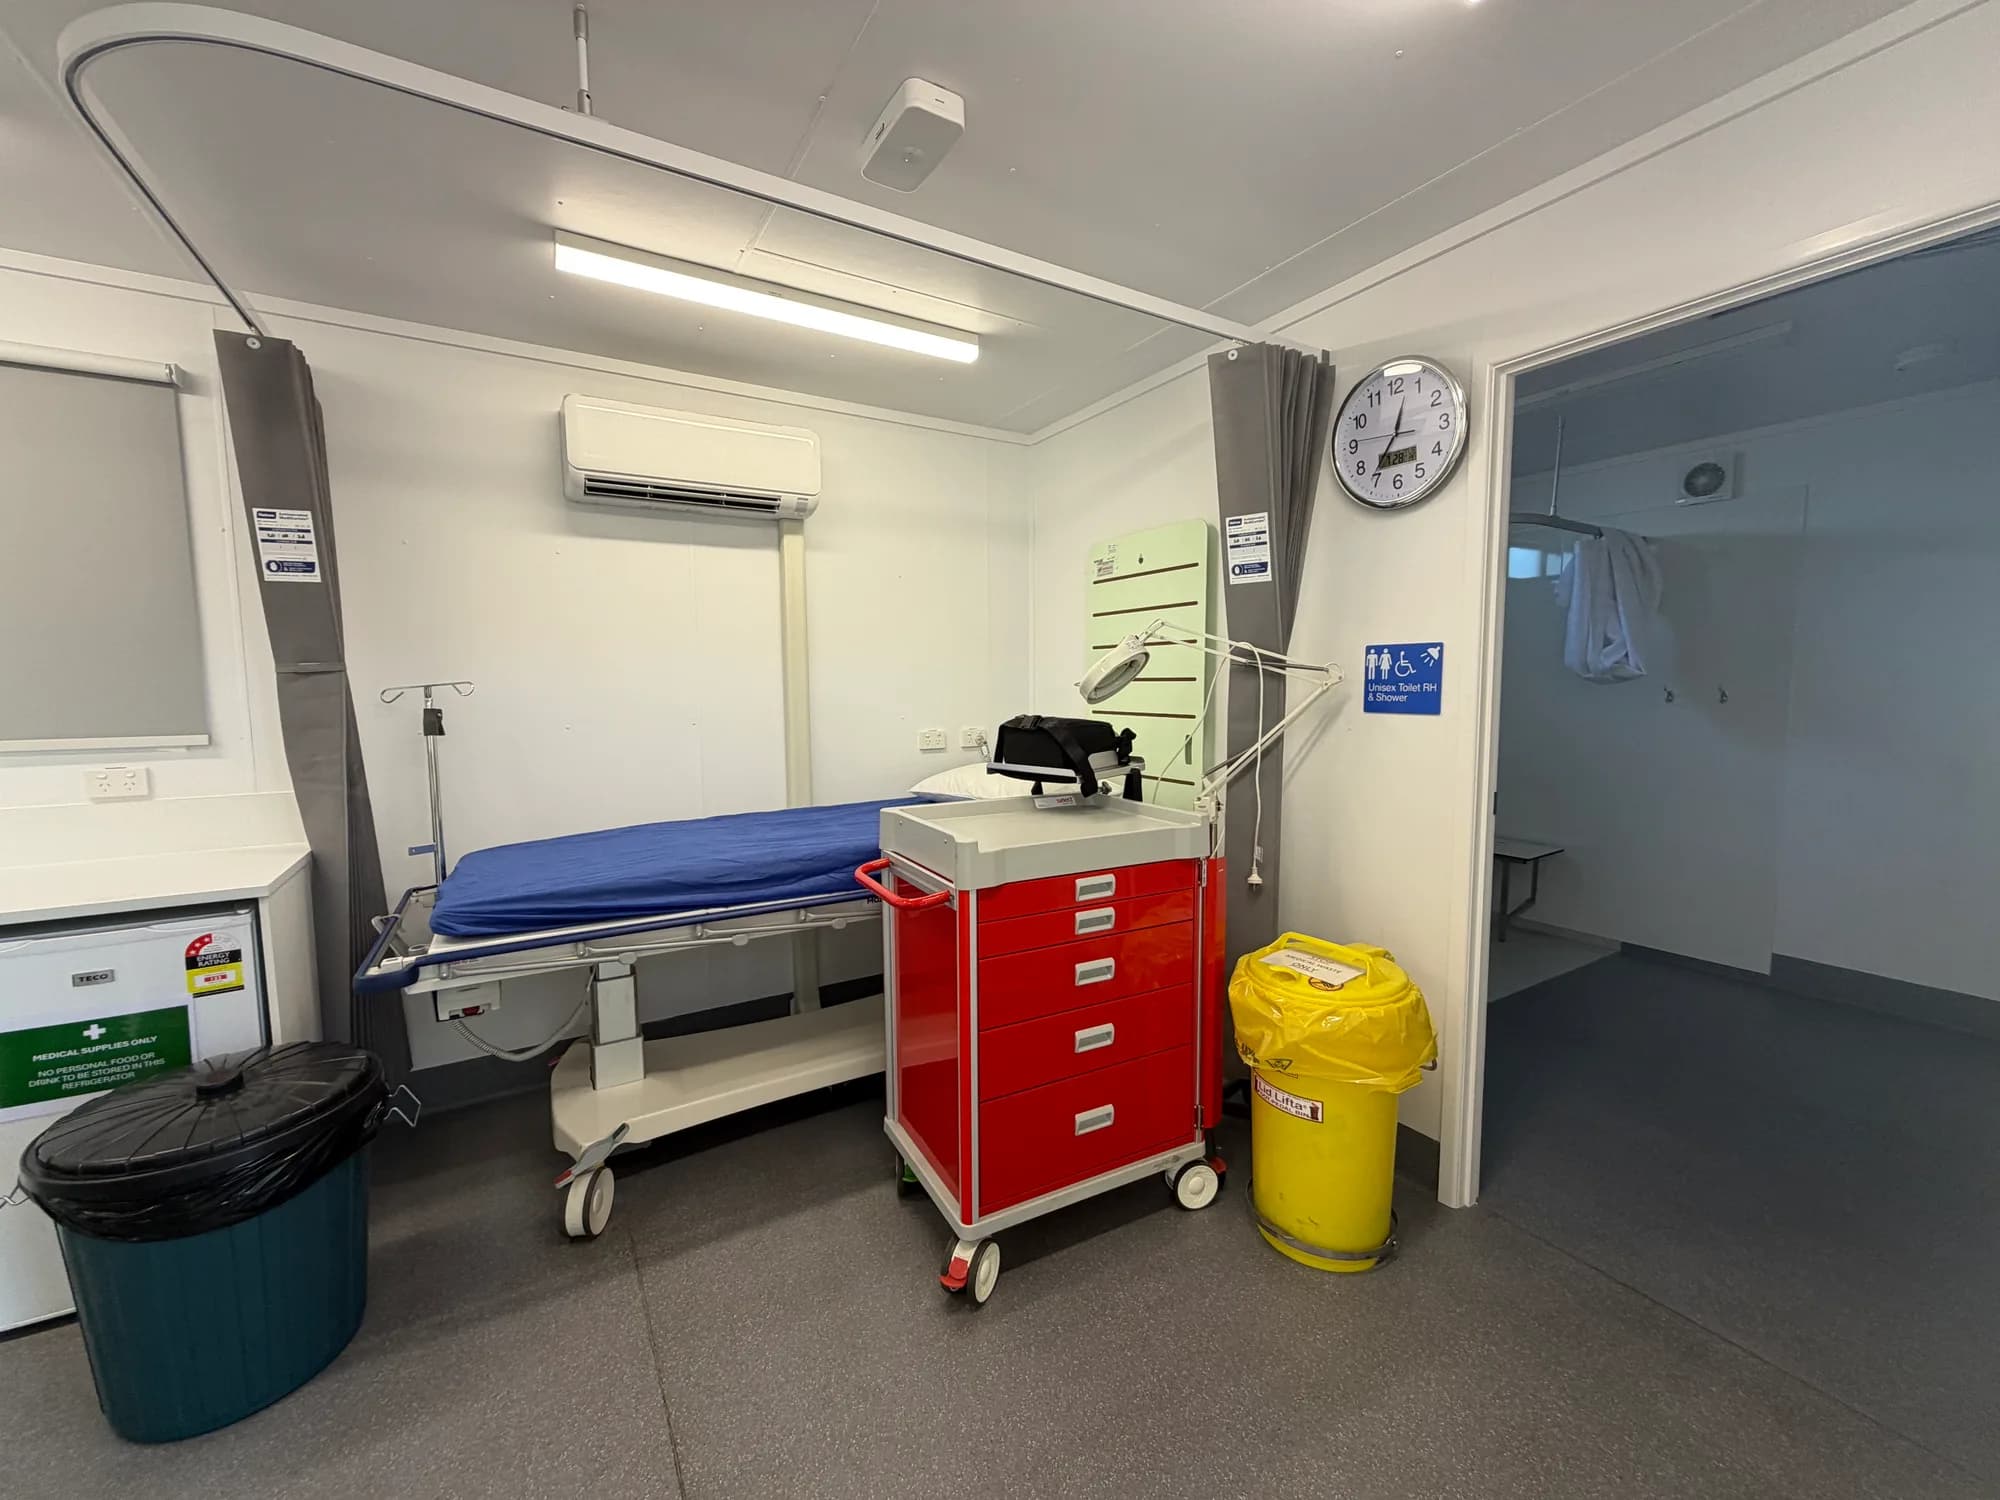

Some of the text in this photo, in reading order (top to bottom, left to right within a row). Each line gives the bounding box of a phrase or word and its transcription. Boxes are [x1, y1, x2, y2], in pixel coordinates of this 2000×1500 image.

[1387, 377, 1404, 396] 12
[1414, 377, 1421, 393] 1
[1367, 391, 1381, 408] 11
[1430, 389, 1442, 407] 2
[1353, 413, 1367, 430] 10
[1439, 413, 1450, 430] 3
[1349, 439, 1358, 454] 9
[1431, 441, 1443, 456] 4
[1356, 460, 1366, 476] 8
[1414, 462, 1426, 478] 5
[1372, 472, 1382, 488] 7
[1392, 474, 1403, 490] 6
[1368, 682, 1437, 692] Unisex Toilet RH
[1367, 692, 1408, 702] & Shower
[197, 951, 230, 963] ENERGY
[198, 957, 230, 967] RATING
[79, 973, 109, 982] TECO
[32, 1035, 158, 1062] MEDICAL SUPPLIES ONLY
[28, 1058, 166, 1088] DRINK TO BE STORED IN THIS
[38, 1052, 155, 1078] NO PERSONAL FOOD OR
[61, 1071, 136, 1090] REFRIGERATOR
[1258, 1080, 1272, 1096] Lid
